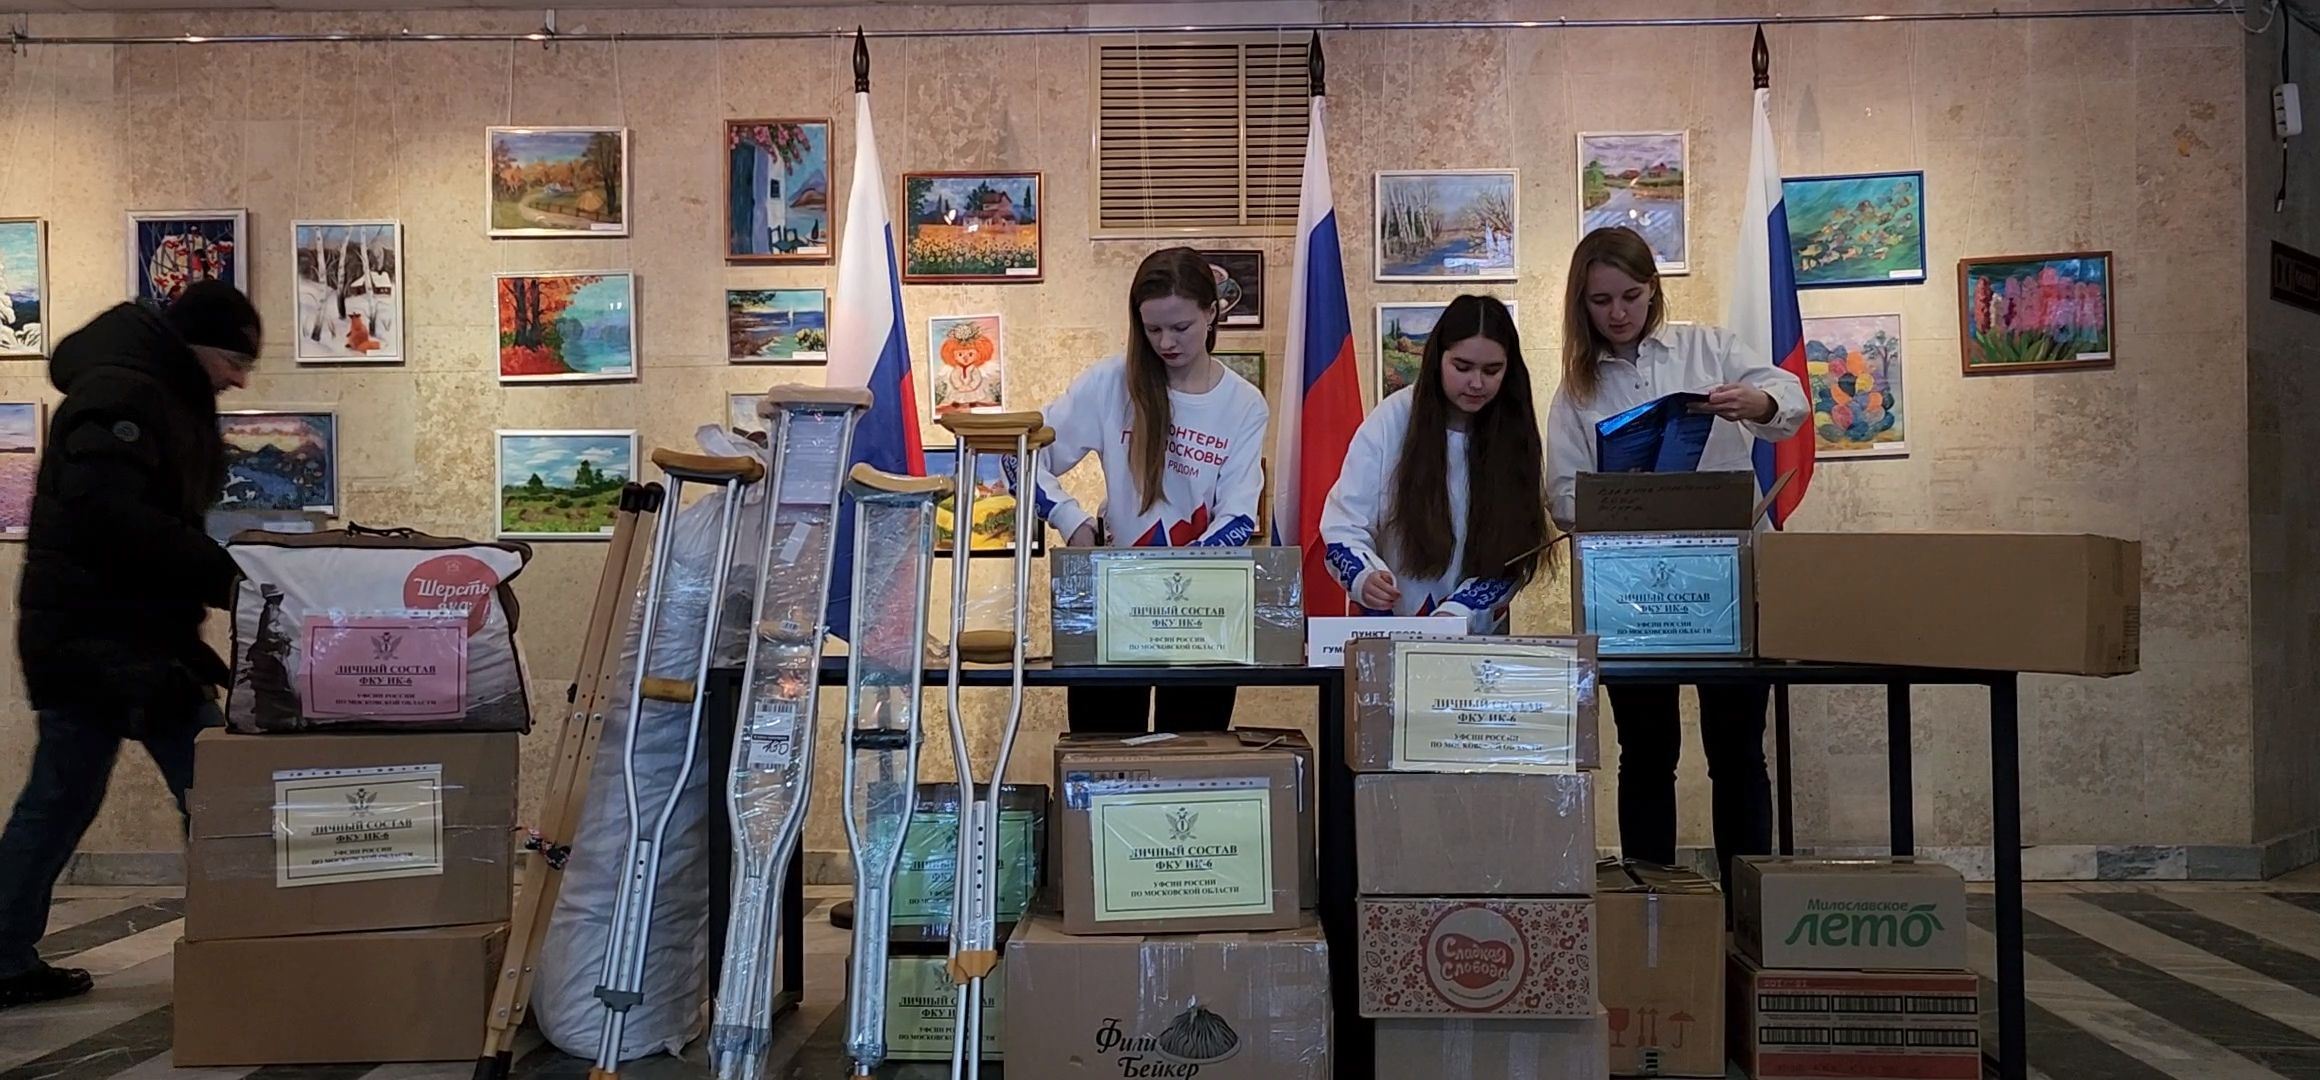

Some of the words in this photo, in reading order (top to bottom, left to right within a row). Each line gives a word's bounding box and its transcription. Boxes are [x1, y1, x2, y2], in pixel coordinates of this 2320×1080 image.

[1168, 423, 1229, 450] ОНТЕРЫ
[1168, 460, 1199, 477] РЯДОМ
[414, 577, 490, 602] Шерсть
[1667, 592, 1711, 602] СОСТАВ
[1129, 606, 1178, 616] ЛИЧНЫЙ
[1180, 606, 1225, 616] СОСТАВ
[1664, 604, 1689, 613] ИК-6
[1152, 619, 1176, 627] ФКУ
[1178, 619, 1203, 627] ИК-6
[1351, 630, 1386, 638] ПУНКТ
[335, 664, 387, 674] ЛИЧНЫЙ
[389, 665, 436, 674] СОСТАВ
[359, 676, 384, 685] ФКУ
[387, 676, 412, 685] ИК-6
[1432, 697, 1488, 709] ЛИЧНЫЙ
[1458, 713, 1485, 722] ФКУ
[1488, 713, 1517, 722] ИК-6
[312, 820, 363, 835] ЛИЧНЫЙ
[366, 818, 412, 829] СОСТАВ
[336, 834, 360, 843] ФКУ
[364, 831, 389, 841] ИК-6
[1129, 845, 1185, 859] ЛИЧНЫЙ
[1188, 845, 1238, 856] СОСТАВ
[1155, 861, 1183, 870] ФКУ
[1185, 859, 1213, 869] ИК-6
[1144, 887, 1200, 896] МОСКОВСКОЙ
[1202, 885, 1239, 894] ОБЛАСТИ
[1807, 899, 1908, 912] Милославское
[1785, 904, 1944, 947] лето
[1442, 937, 1507, 964] Сладкая
[1442, 961, 1509, 980] Слобода
[899, 996, 948, 1006] ЛИЧНЫЙ
[921, 1008, 946, 1017] ФКУ
[1096, 1017, 1157, 1054] Фили
[1118, 1055, 1199, 1080] Бейкер
